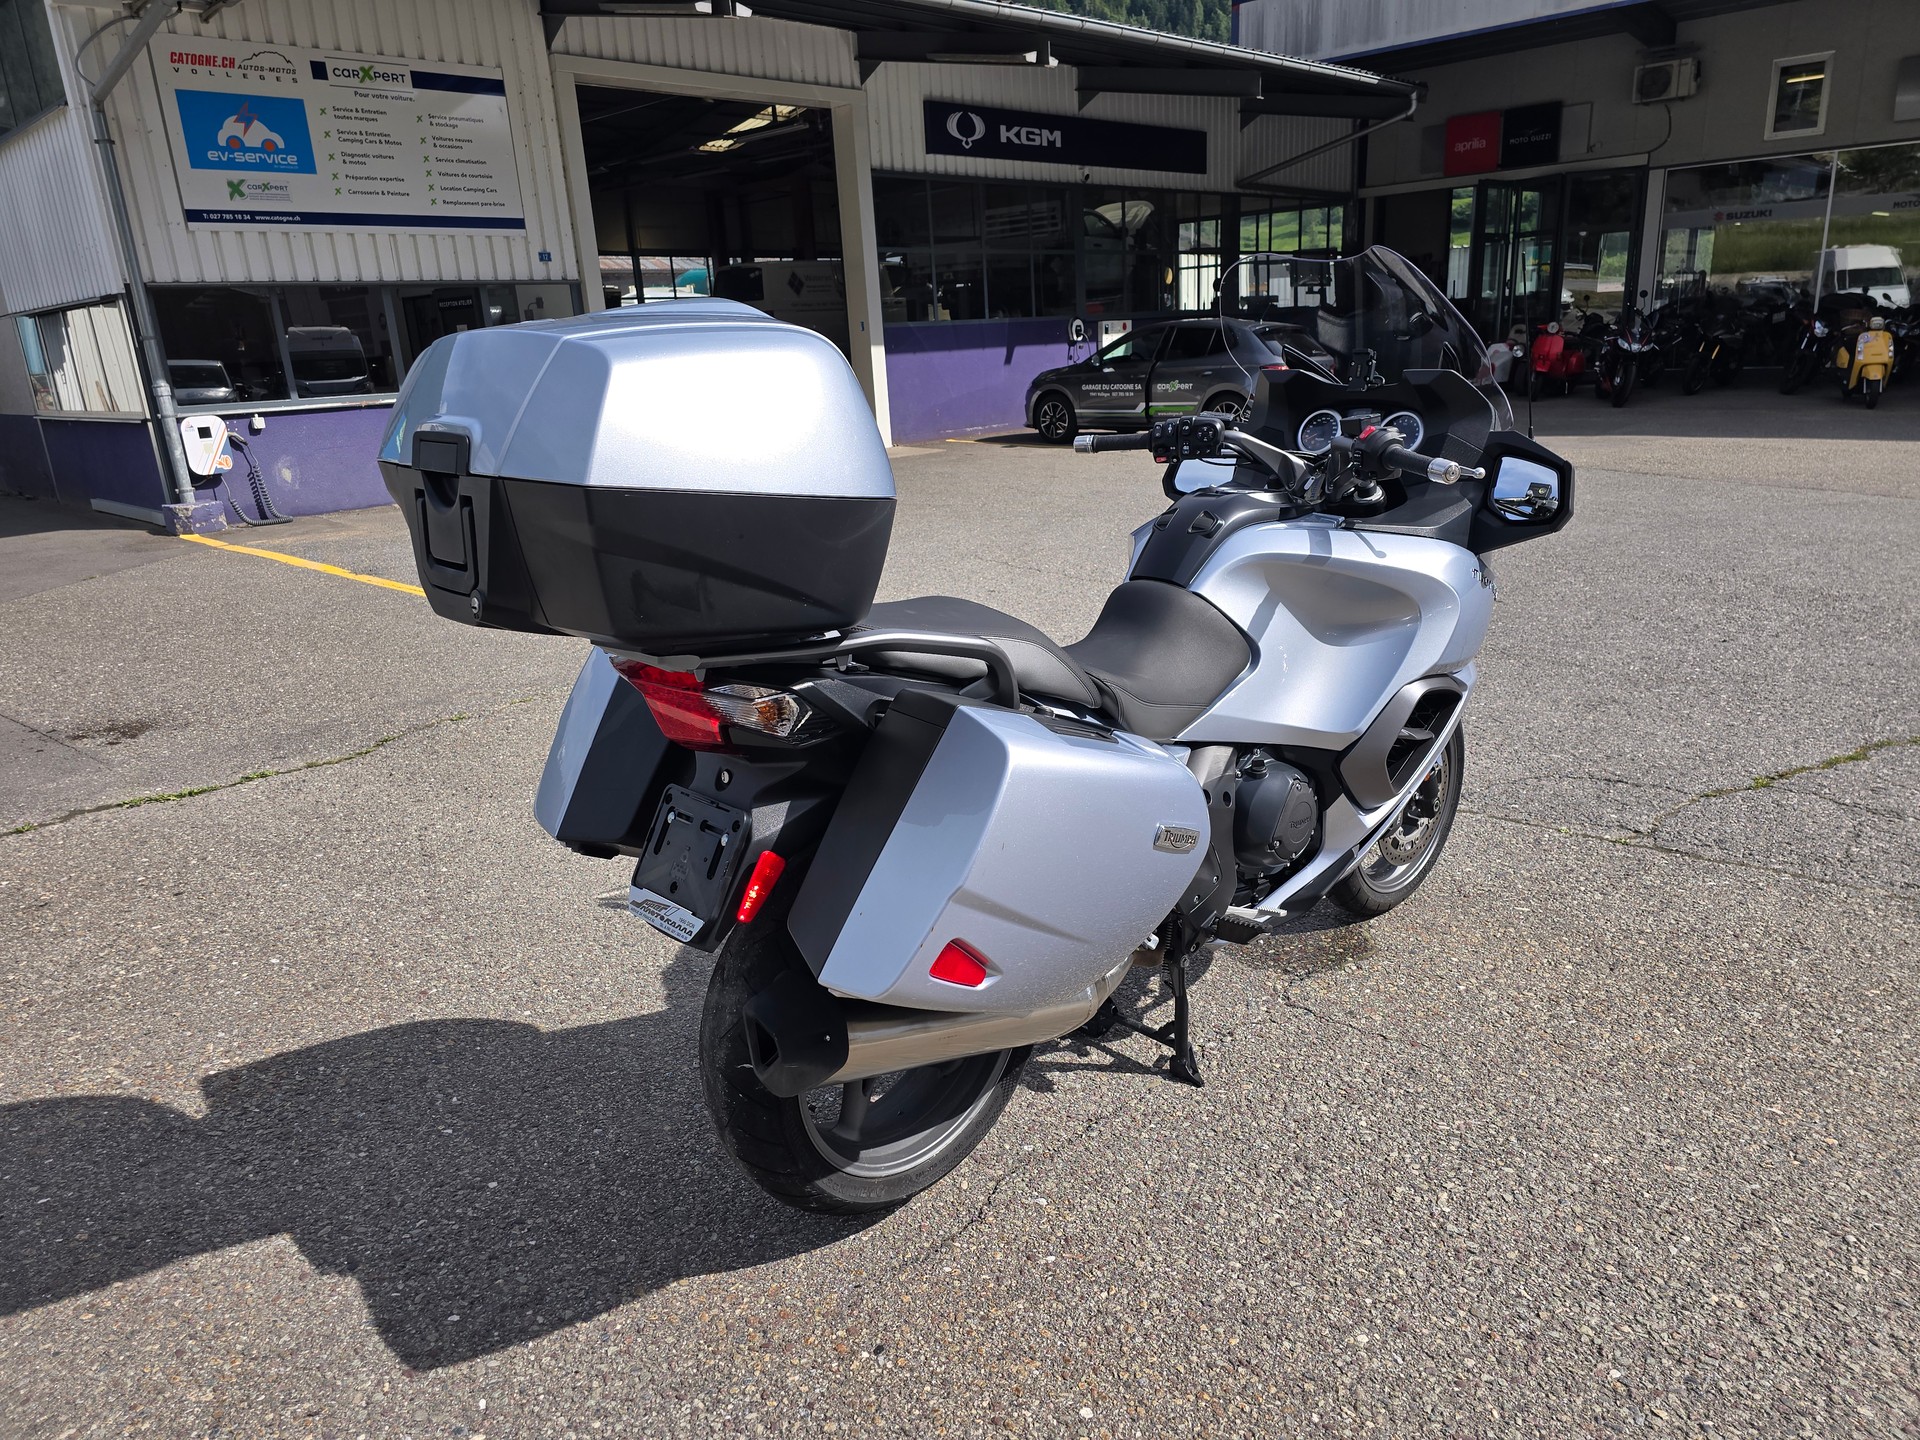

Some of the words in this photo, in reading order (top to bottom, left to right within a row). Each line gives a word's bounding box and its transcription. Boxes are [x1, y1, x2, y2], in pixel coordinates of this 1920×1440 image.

[170, 52, 236, 68] CATOGNE.CH
[238, 64, 296, 74] AUTOS-MOTOS
[390, 94, 415, 102] voiture.
[338, 136, 364, 144] Camping
[1000, 124, 1062, 148] KGM
[1510, 136, 1528, 144] MOTO
[1530, 133, 1552, 142] GUZZI
[1454, 138, 1486, 152] aprilia
[207, 150, 298, 164] ev-service
[1893, 200, 1920, 209] MOTO
[1726, 210, 1772, 220] SUZUKI
[1164, 830, 1196, 847] TRIUMPH
